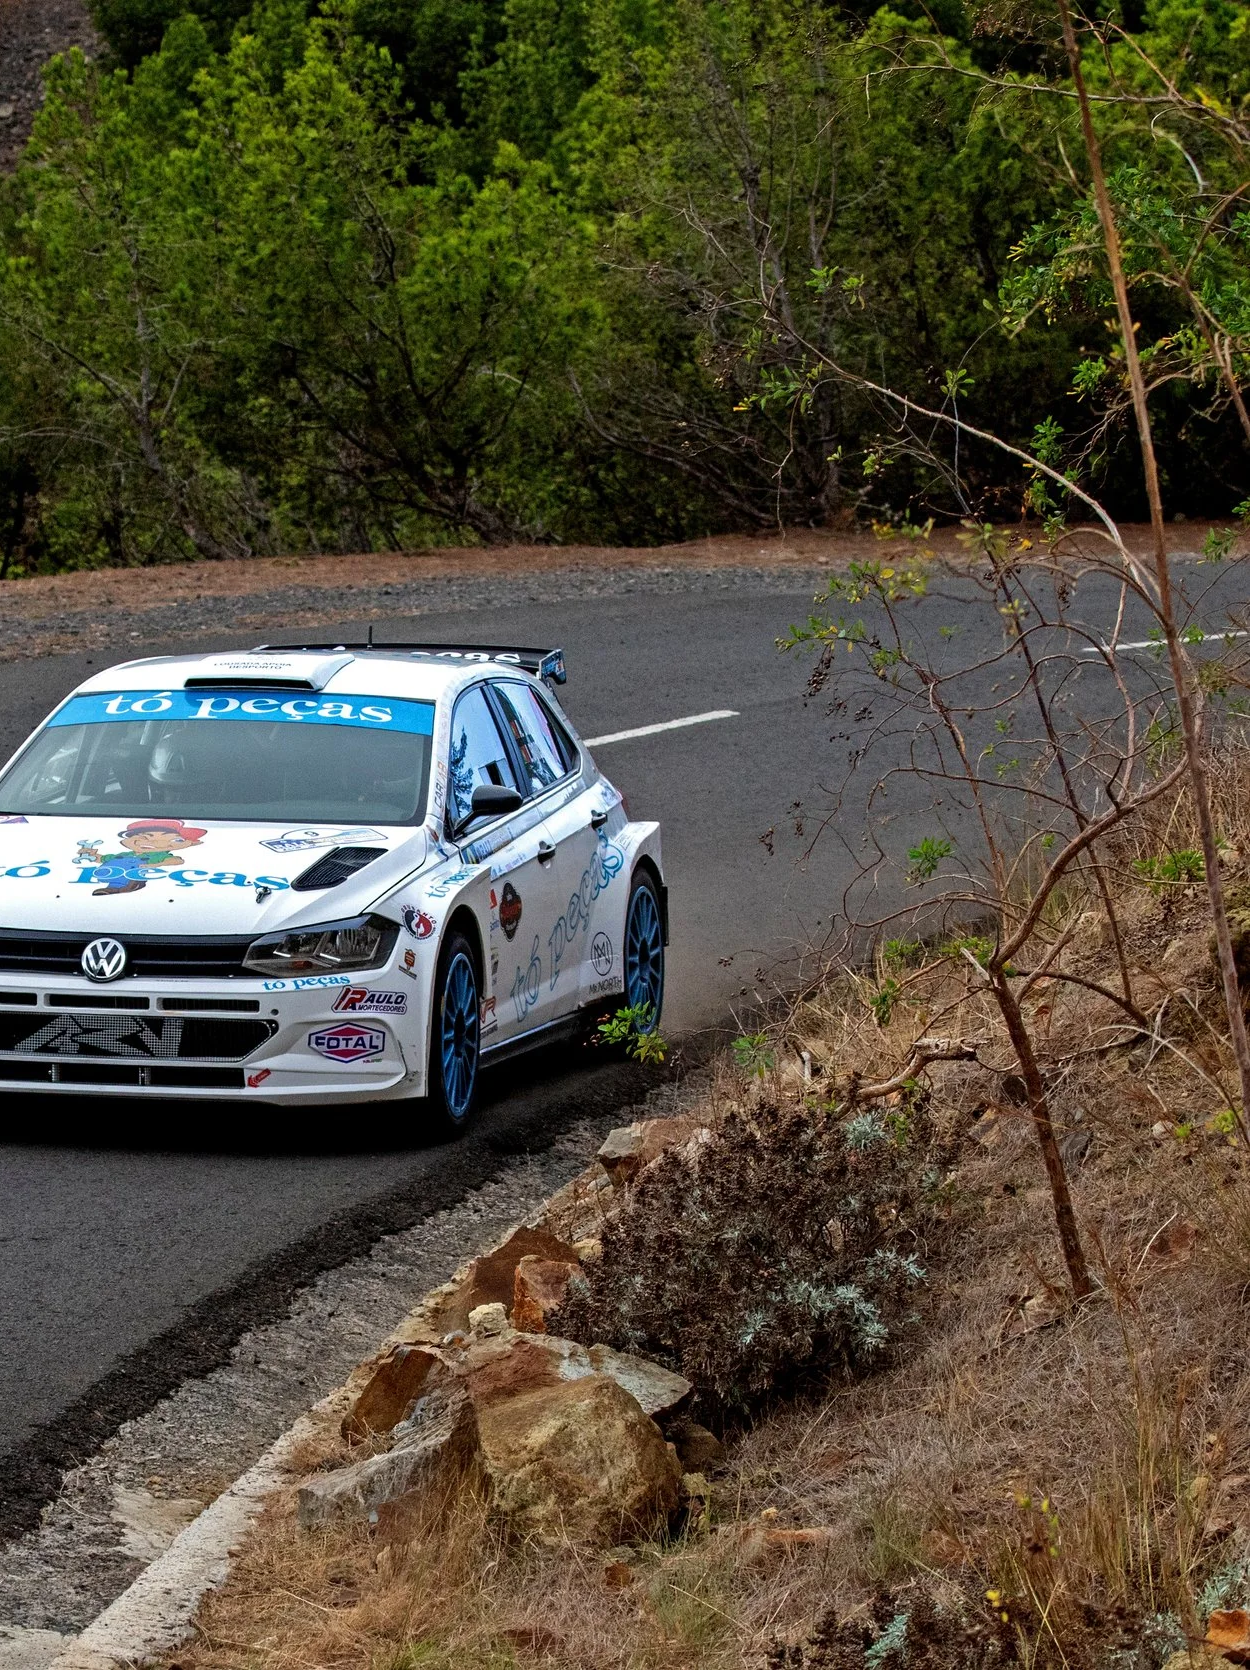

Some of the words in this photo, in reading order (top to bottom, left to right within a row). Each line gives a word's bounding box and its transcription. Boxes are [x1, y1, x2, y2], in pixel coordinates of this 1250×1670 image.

[103, 691, 173, 715] tó
[187, 696, 393, 723] peças
[67, 865, 291, 891] peças
[509, 934, 542, 1024] tó
[548, 828, 625, 992] peças
[262, 980, 286, 991] tó
[293, 975, 350, 990] peças
[338, 987, 405, 1011] PAULO
[314, 1034, 379, 1050] FOTAL
